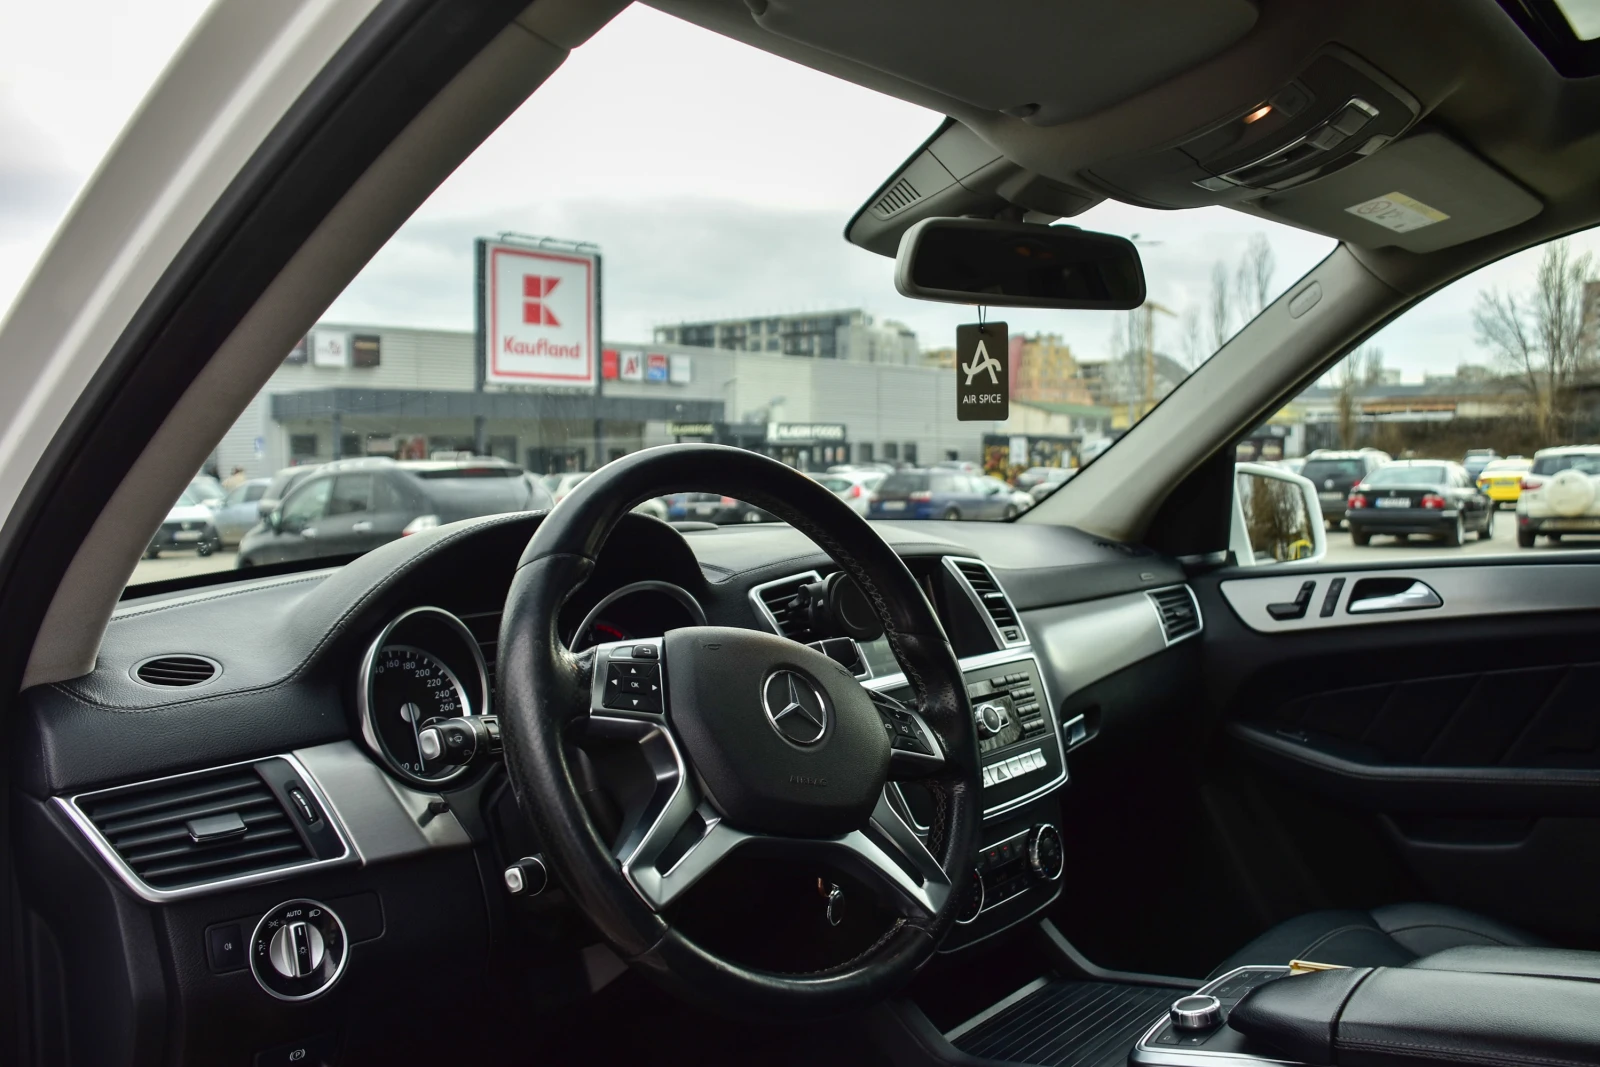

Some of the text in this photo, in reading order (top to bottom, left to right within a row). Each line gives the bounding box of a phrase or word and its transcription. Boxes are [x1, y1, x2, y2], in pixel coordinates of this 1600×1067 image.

[503, 336, 581, 359] Kaufland
[963, 394, 1002, 404] AIR SPICE
[386, 659, 400, 669] 160
[402, 661, 416, 670] 180
[415, 668, 430, 678] 200
[426, 678, 442, 687] 220
[630, 681, 640, 689] OK
[434, 689, 450, 699] 240
[439, 702, 455, 712] 260
[286, 910, 302, 918] AUTO
